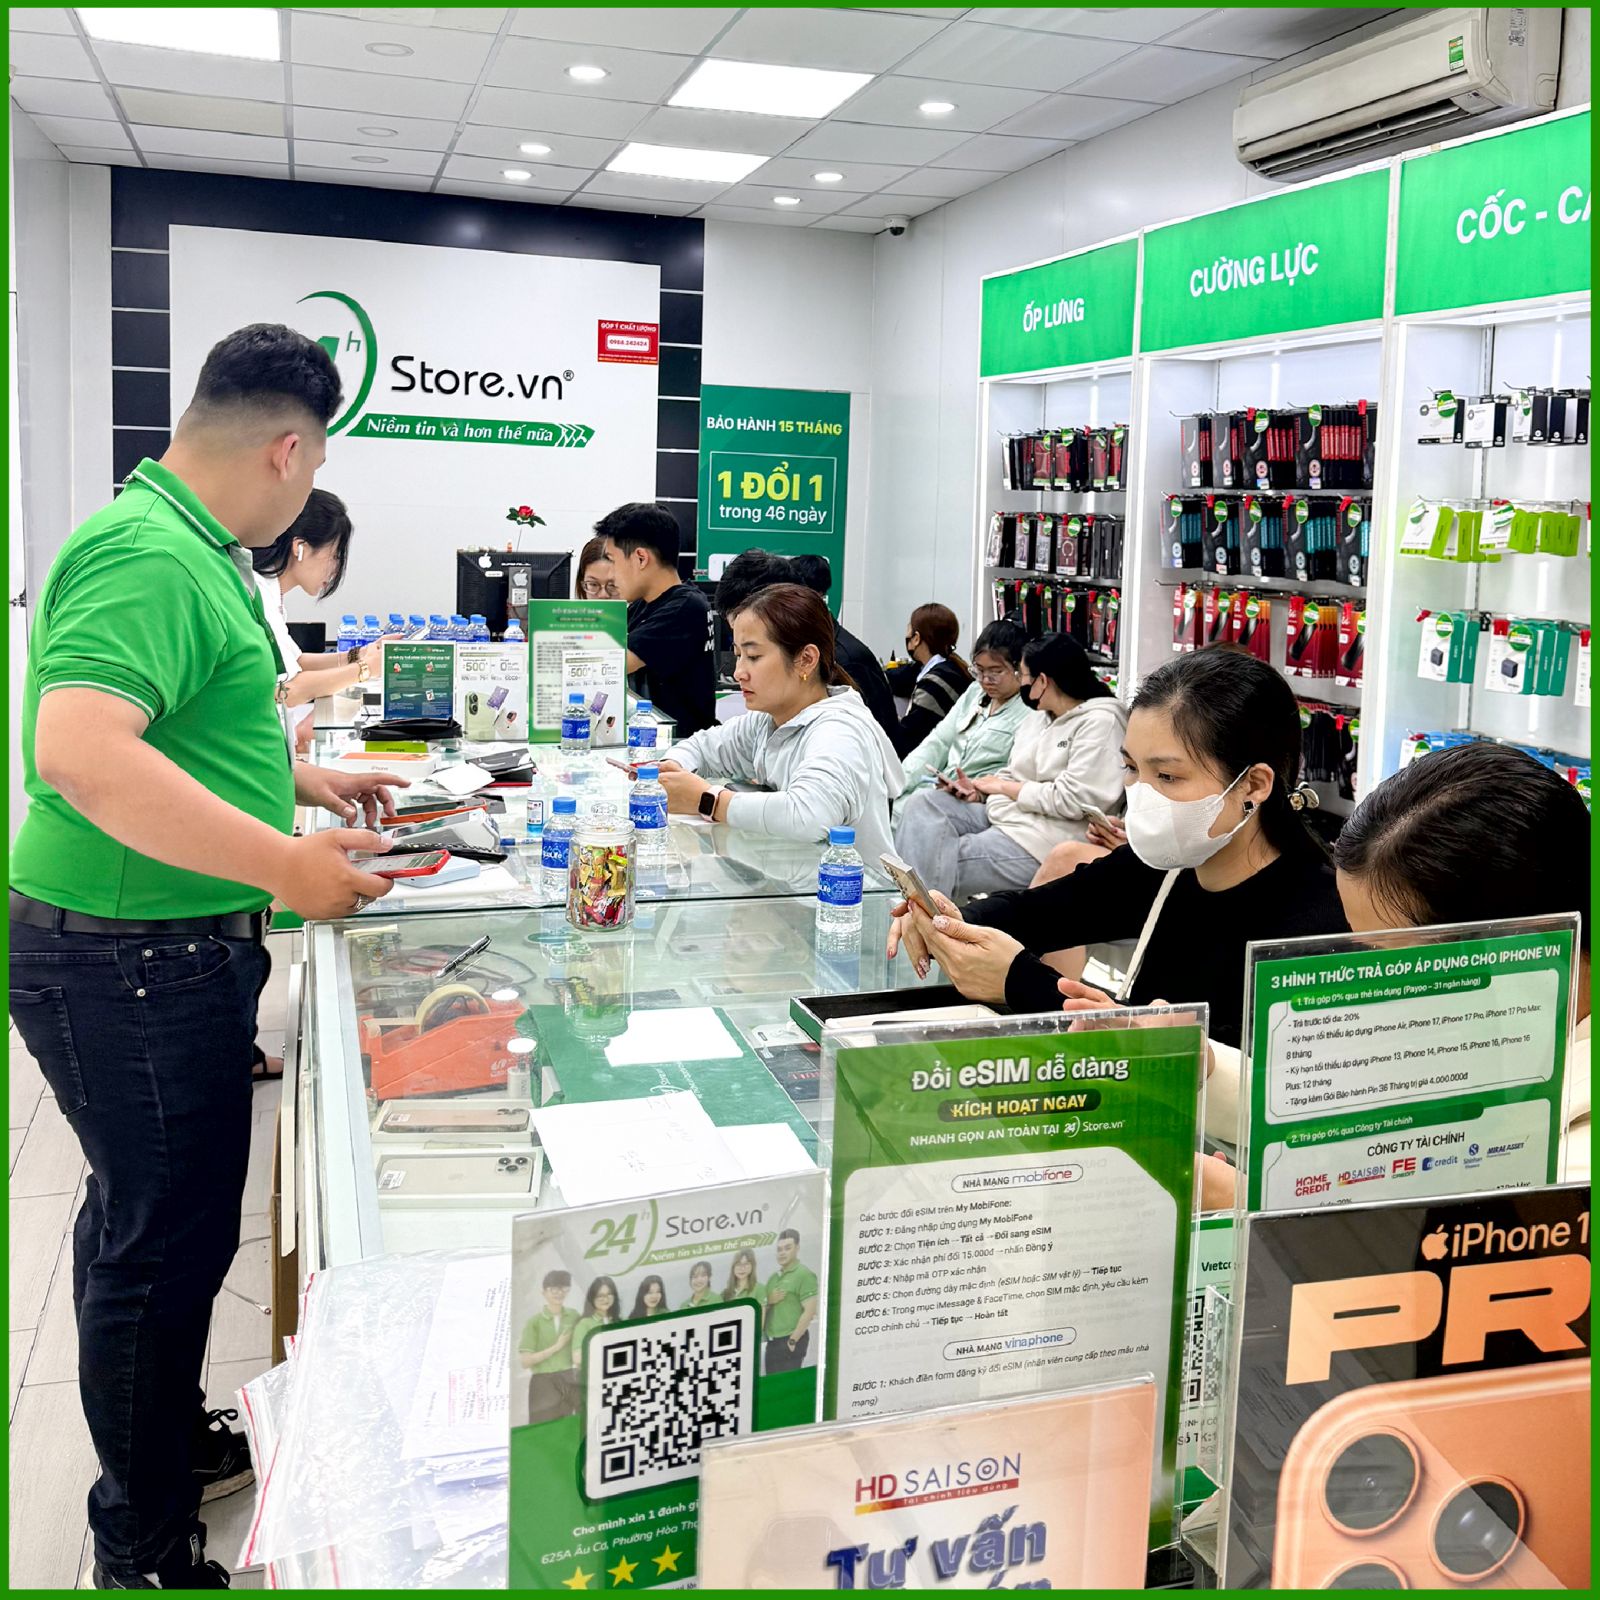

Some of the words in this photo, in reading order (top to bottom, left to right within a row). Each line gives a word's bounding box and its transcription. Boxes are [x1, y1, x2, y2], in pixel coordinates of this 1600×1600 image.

[1456, 190, 1526, 243] CỐC
[1190, 256, 1265, 297] CƯỜNG
[1270, 243, 1319, 286] LỰC
[1023, 302, 1042, 332] ỐP
[1044, 298, 1085, 328] LƯNG
[366, 415, 410, 435] Niềm
[415, 420, 436, 436] tin
[442, 421, 459, 437] và
[464, 423, 492, 438] hơn
[497, 423, 527, 440] thế
[526, 426, 553, 441] nữa
[706, 414, 734, 430] BẢO
[737, 416, 776, 432] HÀNH
[778, 420, 794, 433] 15
[796, 419, 843, 435] THÁNG
[717, 470, 732, 498] 1
[740, 461, 801, 501] ĐỔI
[808, 474, 823, 502] 1
[719, 504, 762, 523] trong
[765, 505, 786, 521] 46
[788, 506, 827, 525] ngày
[1271, 975, 1280, 989] 3
[1282, 971, 1316, 988] HÌNH
[1318, 965, 1354, 984] THỨC
[1357, 961, 1383, 979] TRẢ
[1385, 960, 1412, 976] GÓP
[1414, 957, 1430, 973] ÁP
[1433, 955, 1469, 972] DỤNG
[1470, 952, 1497, 966] CHO
[1499, 946, 1542, 963] IPHONE
[1544, 944, 1561, 957] VN
[1316, 993, 1330, 1004] góp
[1331, 991, 1344, 1003] 0%
[1344, 989, 1359, 1001] qua
[1402, 981, 1426, 994] (Payoo
[1286, 1050, 1291, 1060] 8
[912, 1061, 952, 1092] Đổi
[958, 1057, 1030, 1086] eSIM
[1037, 1053, 1067, 1082] dễ
[1071, 1056, 1130, 1081] dàng
[1303, 1079, 1311, 1089] 12
[952, 1100, 992, 1117] KÍCH
[996, 1098, 1039, 1115] HOẠT
[1043, 1094, 1088, 1111] NGAY
[910, 1133, 956, 1146] NHANH
[958, 1130, 985, 1144] GỌN
[987, 1128, 1005, 1139] AN
[1007, 1123, 1040, 1138] TOÀN
[1042, 1124, 1060, 1137] TẠI
[1312, 1129, 1326, 1140] góp
[1327, 1126, 1340, 1137] 0%
[1340, 1124, 1354, 1135] qua
[1367, 1142, 1398, 1157] CÔNG
[1400, 1139, 1413, 1151] TY
[1415, 1135, 1431, 1148] TÀI
[1432, 1132, 1465, 1146] CHÍNH
[1338, 1169, 1351, 1180] HD
[1351, 1164, 1386, 1178] SAISON
[1392, 1158, 1417, 1174] FE
[1434, 1156, 1459, 1168] credit
[962, 1177, 982, 1188] NHÀ
[983, 1175, 1010, 1188] MẠNG
[1012, 1169, 1073, 1184] mobifone
[1295, 1181, 1332, 1197] CREDIT
[1296, 1173, 1328, 1187] HOME
[915, 1205, 936, 1217] eSIM
[955, 1202, 969, 1214] My
[969, 1198, 1012, 1212] MobiFone:
[957, 1216, 978, 1229] dụng
[979, 1215, 992, 1227] My
[993, 1211, 1033, 1226] MobiFone
[584, 1212, 638, 1260] 24
[1452, 1222, 1569, 1258] iPhone
[1286, 1254, 1591, 1386] PR
[956, 1342, 975, 1356] NHÀ
[977, 1339, 1003, 1353] MẠNG
[1005, 1330, 1064, 1350] vinaphone
[855, 1471, 898, 1504] HD
[904, 1452, 1021, 1496] SAISON
[572, 1526, 595, 1537] Cho
[597, 1517, 626, 1532] mình
[629, 1513, 646, 1524] xin
[648, 1510, 656, 1520] 1
[657, 1502, 686, 1517] đánh
[541, 1549, 571, 1564] 625A
[656, 1524, 678, 1537] Hòa
[827, 1536, 916, 1589] Tư
[933, 1506, 1046, 1580] vấn
